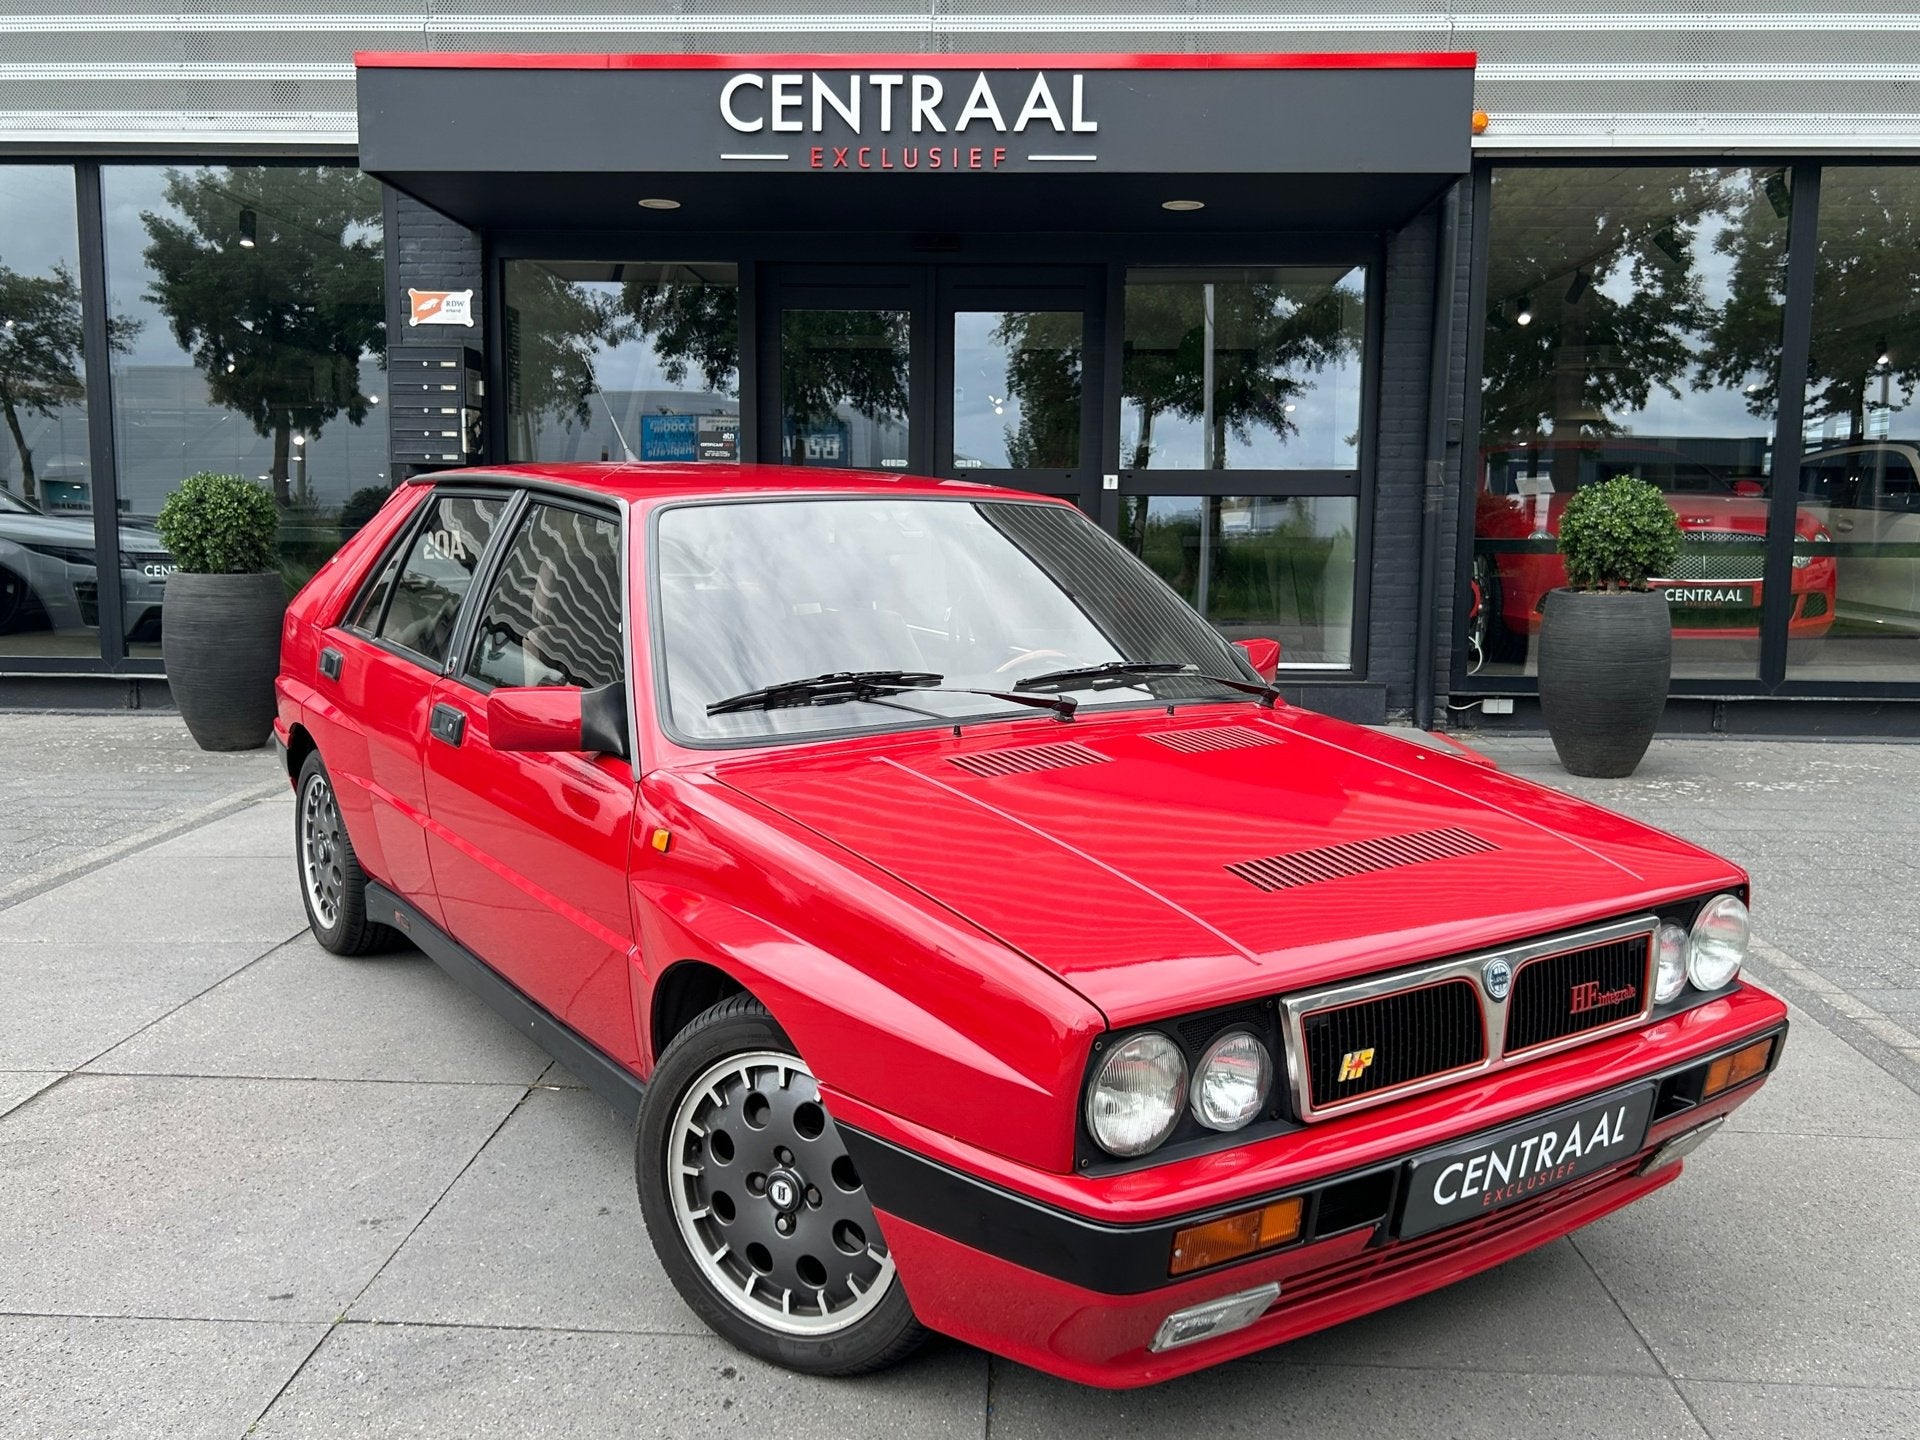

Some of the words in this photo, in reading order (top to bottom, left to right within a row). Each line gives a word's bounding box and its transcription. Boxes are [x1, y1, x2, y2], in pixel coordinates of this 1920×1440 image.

[719, 71, 1098, 134] CENTRAAL
[810, 147, 1007, 169] EXCLUSIEF
[1664, 589, 1743, 601] CENTRAAL
[1570, 981, 1599, 1014] HF
[1338, 1047, 1375, 1082] HF
[1433, 1106, 1626, 1206] CENTRAAL
[1483, 1161, 1576, 1206] EXCLUSIEF
